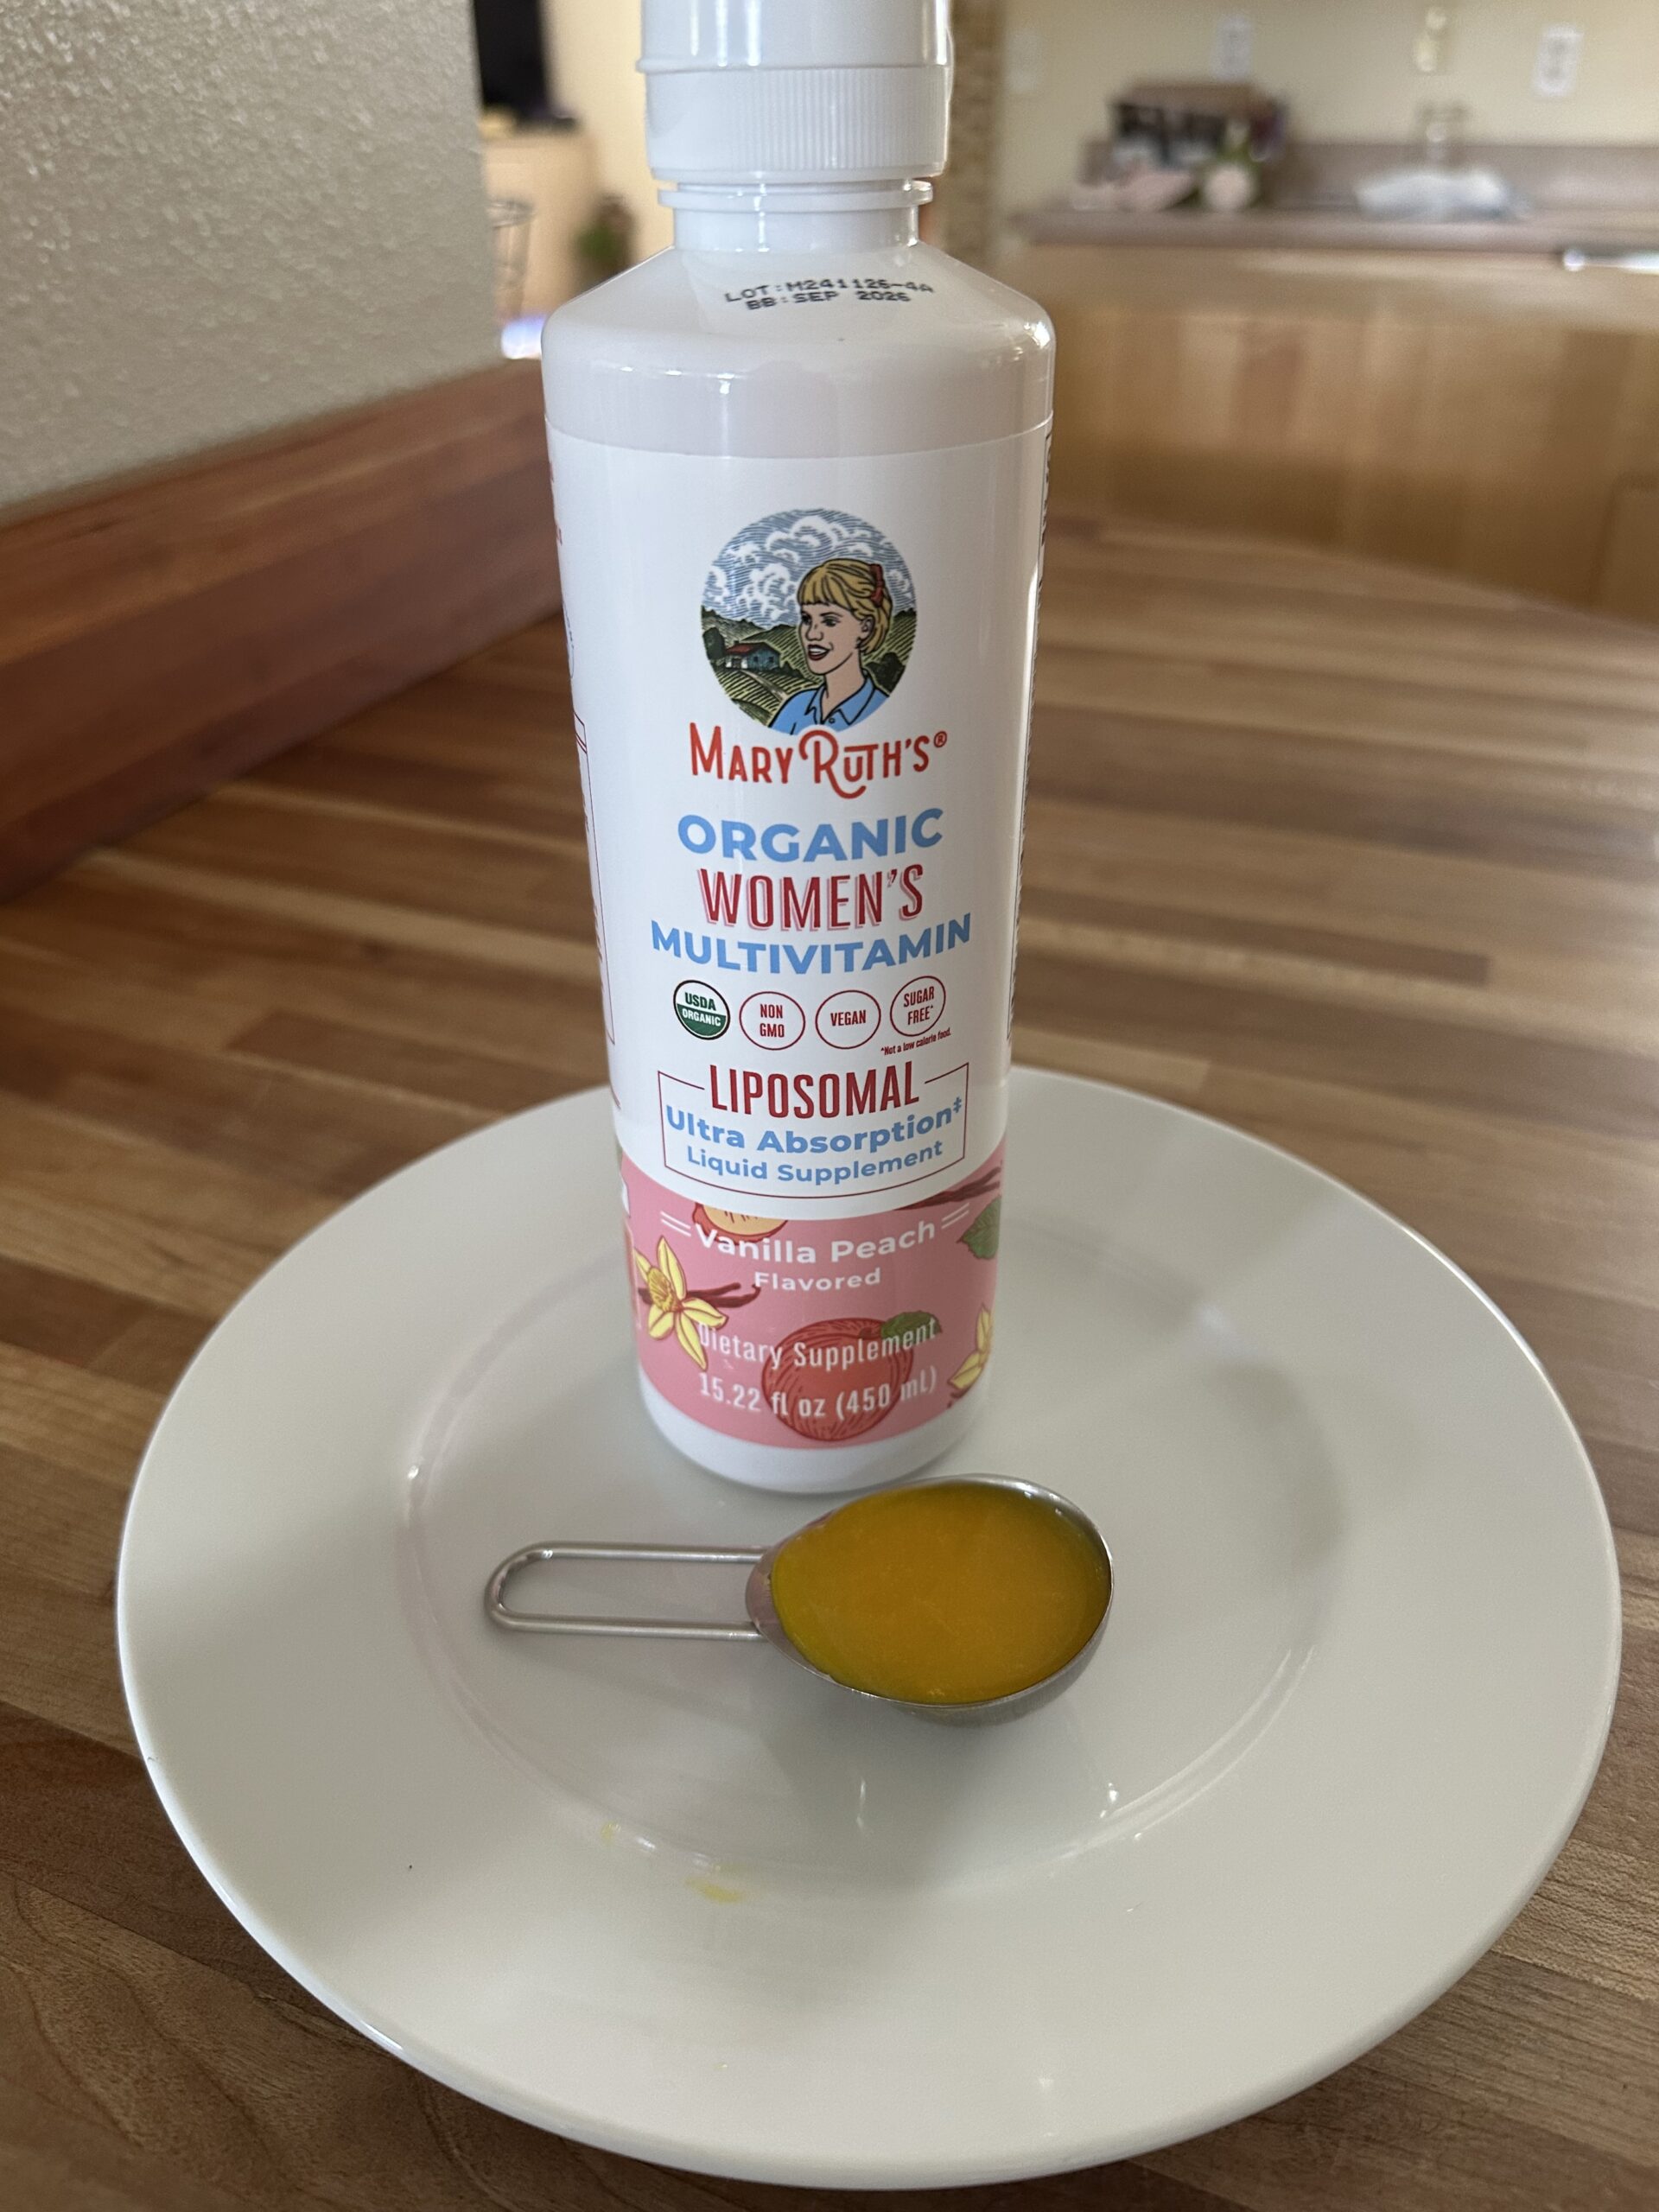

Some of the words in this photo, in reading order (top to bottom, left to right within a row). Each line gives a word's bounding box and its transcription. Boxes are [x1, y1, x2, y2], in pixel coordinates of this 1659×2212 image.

[855, 290, 912, 302] 2026
[690, 722, 792, 784] MARY
[677, 807, 944, 862] ORGANIC
[696, 864, 925, 931] WOMEN'S
[651, 912, 971, 975] MULTIVITAMIN
[682, 1007, 721, 1027] ORGANIC
[684, 992, 716, 1011] USDA
[760, 1003, 784, 1020] NON
[830, 1009, 867, 1027] VEGAN
[903, 986, 935, 1007] SUGAR
[759, 1022, 785, 1039] GMO
[903, 1040, 914, 1051] low
[916, 1034, 937, 1047] calorie
[709, 1061, 920, 1119] LIPOSOMAL
[665, 1104, 746, 1149] Ultra
[687, 1146, 768, 1180] Liquid
[778, 1140, 944, 1186] Supplement
[694, 1223, 817, 1264] Vanilla
[831, 1219, 936, 1262] Peach
[754, 1267, 881, 1292] Flavored
[698, 1322, 783, 1370] Dietary
[793, 1318, 939, 1371] Supplement
[698, 1372, 761, 1412] 15.22
[772, 1392, 788, 1415] fl
[798, 1396, 826, 1416] oz
[835, 1385, 890, 1421] (450
